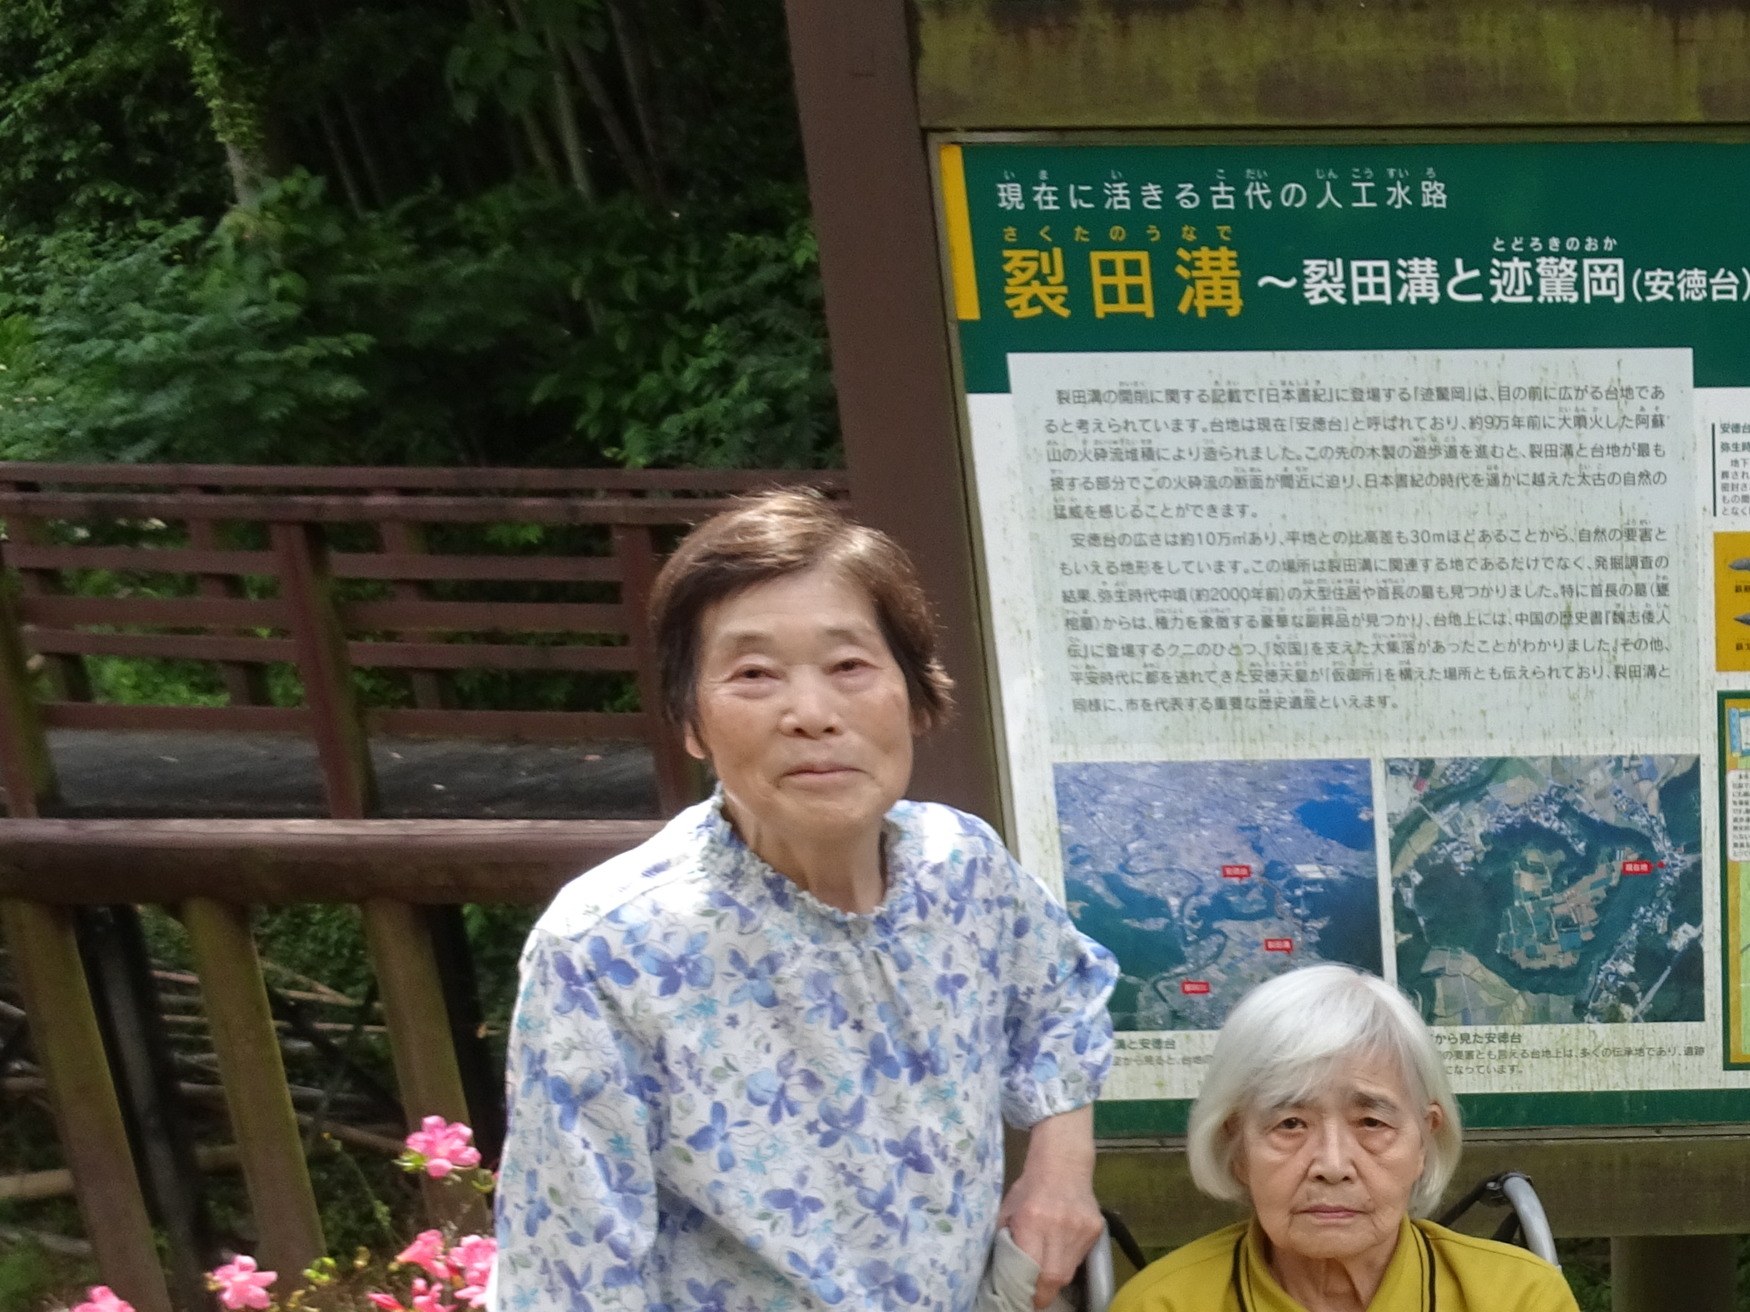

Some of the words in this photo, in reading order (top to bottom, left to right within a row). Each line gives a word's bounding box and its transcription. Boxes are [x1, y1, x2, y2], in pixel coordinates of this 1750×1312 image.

[997, 179, 1449, 211] 現在に活きる古代の人工水路
[1002, 225, 1232, 242] さくたのうなで
[1493, 236, 1617, 252] とどろきのおか
[1001, 246, 1244, 319] 裂田溝
[1431, 1032, 1522, 1045] から見た安徳台
